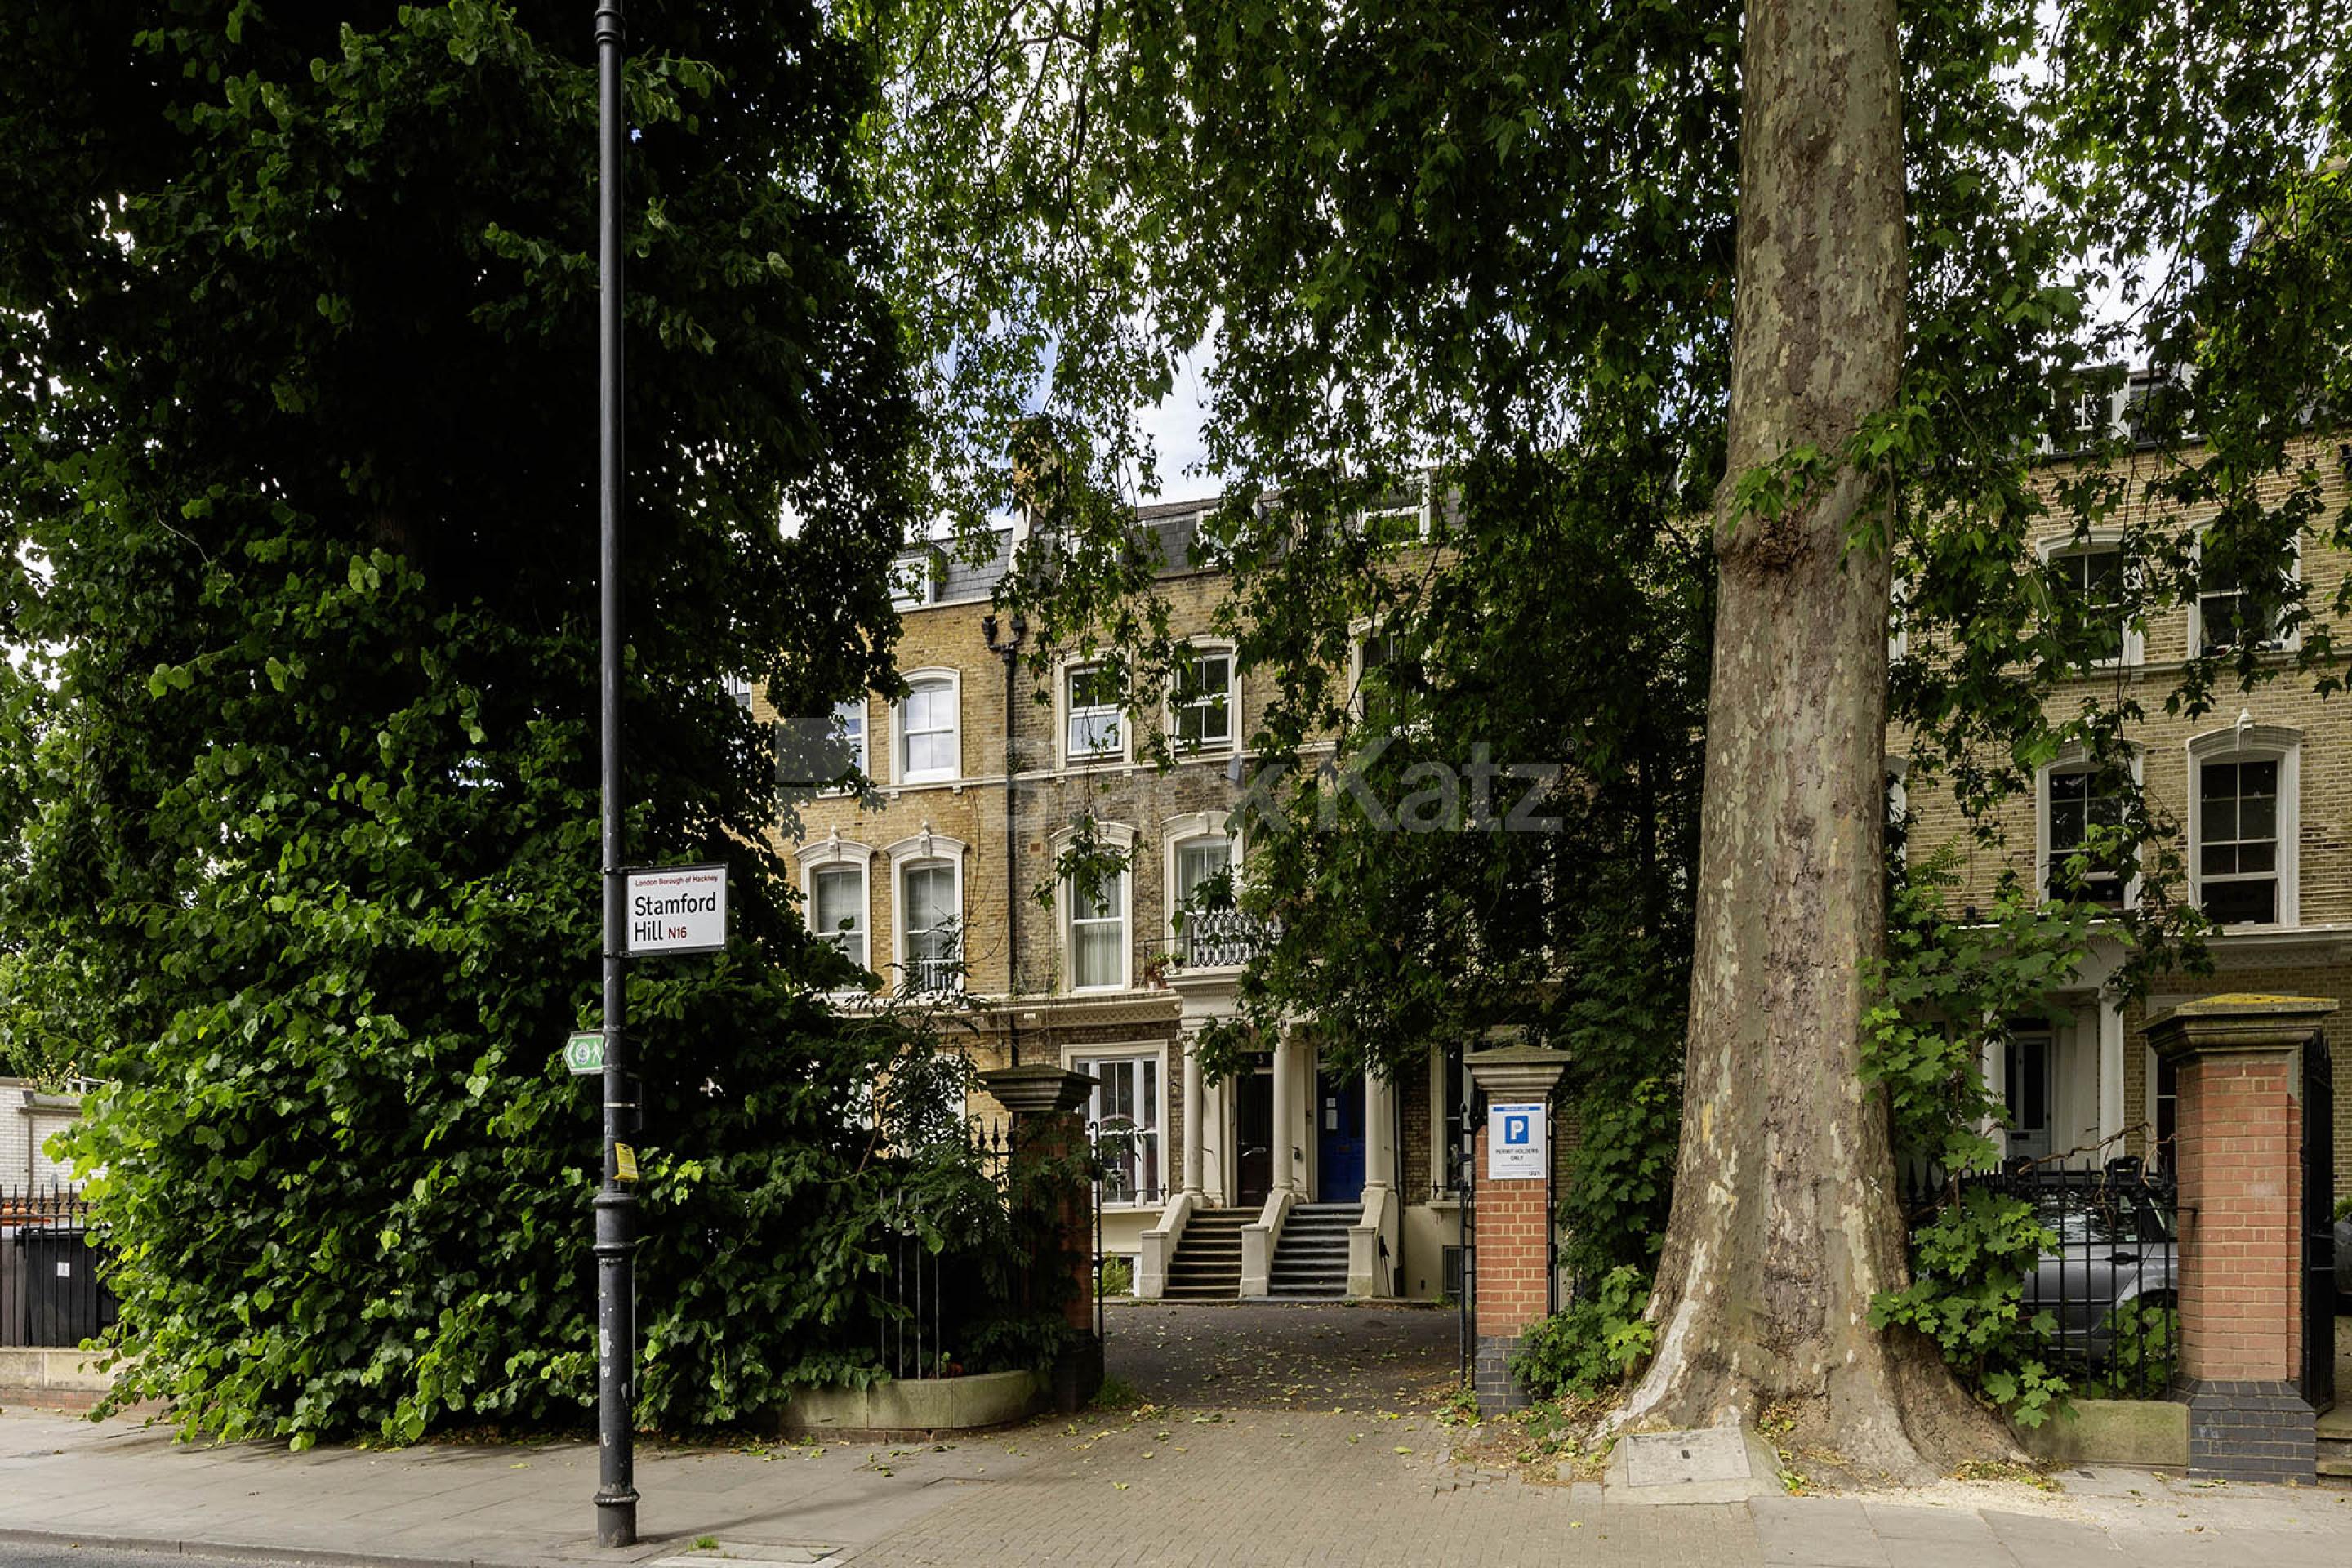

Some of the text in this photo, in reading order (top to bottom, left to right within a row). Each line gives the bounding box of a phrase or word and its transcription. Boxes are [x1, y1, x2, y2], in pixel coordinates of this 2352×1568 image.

[659, 877, 684, 885] Borough
[635, 892, 716, 916] Stamford
[634, 920, 687, 941] Hill N16
[1511, 1120, 1524, 1140] P
